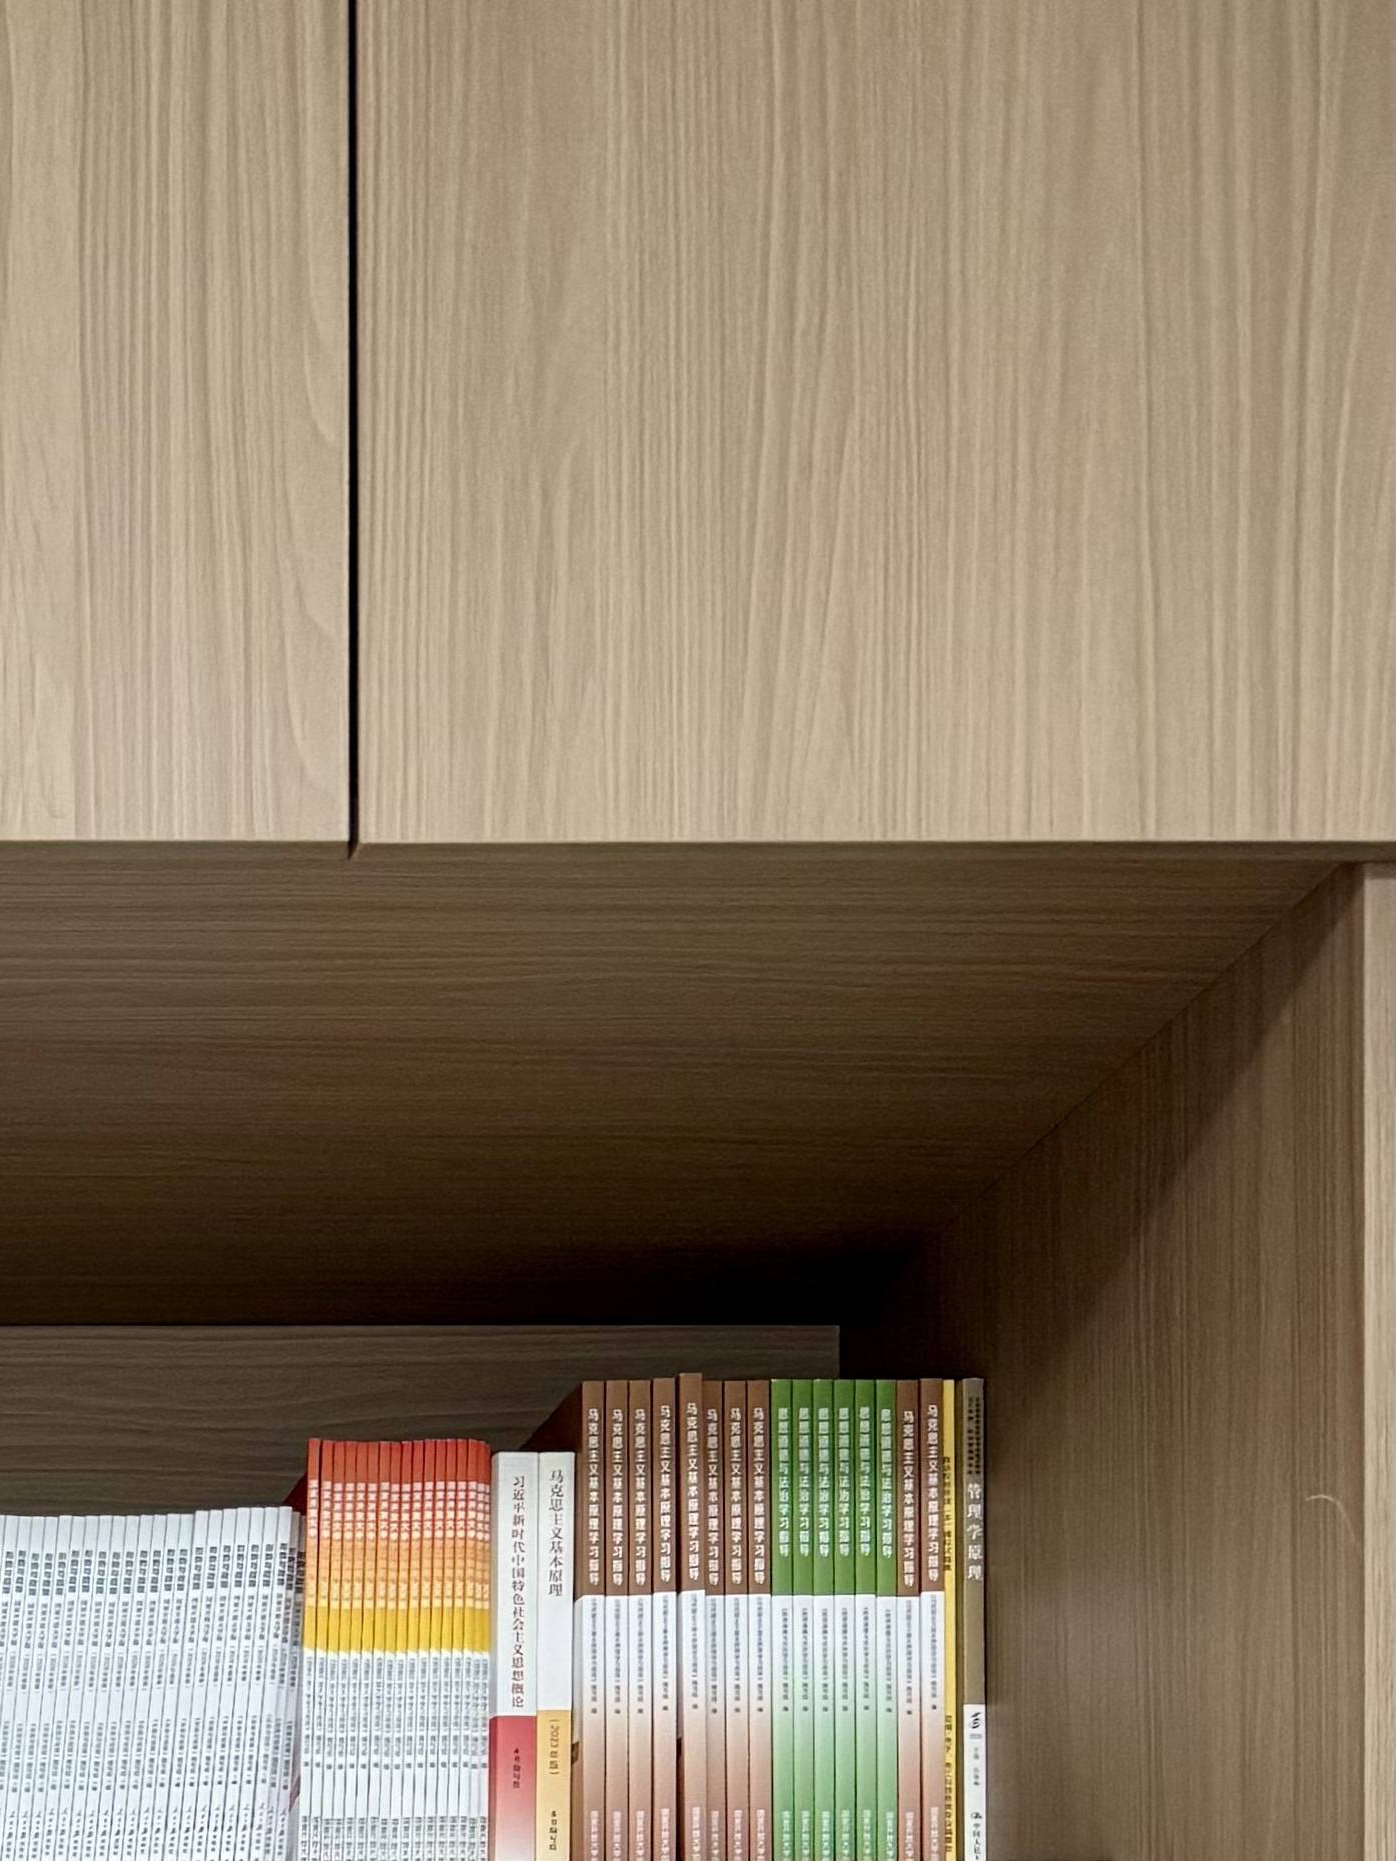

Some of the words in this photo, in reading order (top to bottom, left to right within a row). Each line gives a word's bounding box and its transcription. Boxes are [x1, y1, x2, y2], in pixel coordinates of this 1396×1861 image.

[511, 1475, 525, 1708] 习近平新时代中国特色社会主义思想概论
[548, 1469, 564, 1597] 马克思主义基本原理
